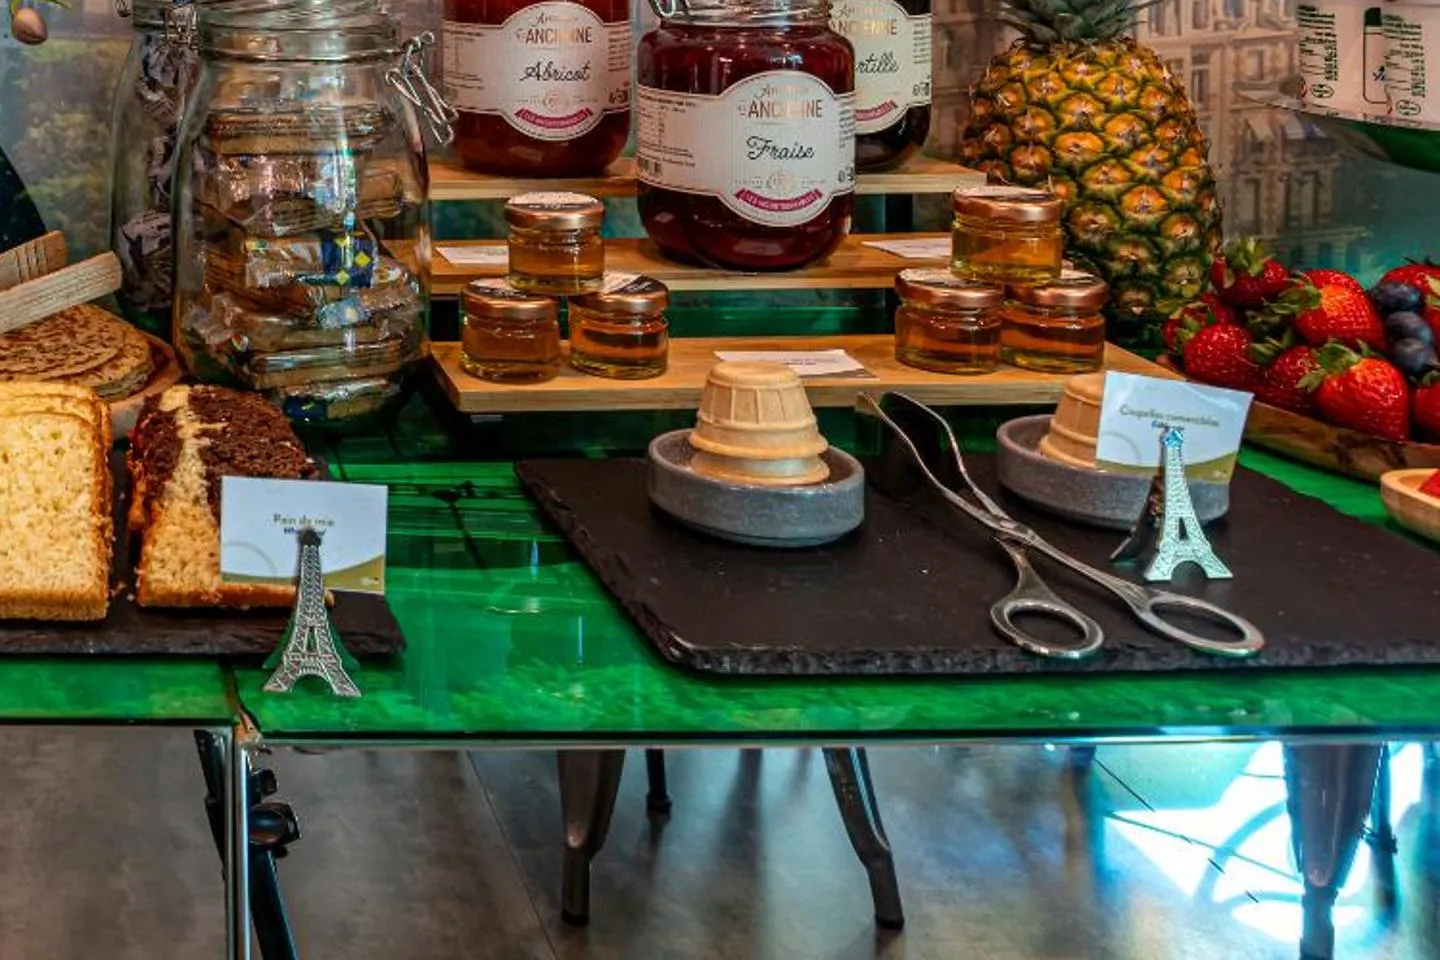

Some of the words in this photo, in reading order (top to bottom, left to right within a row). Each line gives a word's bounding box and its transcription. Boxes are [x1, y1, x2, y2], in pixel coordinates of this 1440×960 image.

[525, 26, 592, 44] ANCINE
[519, 60, 591, 82] Abricot
[855, 50, 900, 74] rtille
[748, 100, 823, 119] ANCINE
[746, 136, 815, 160] Fraise
